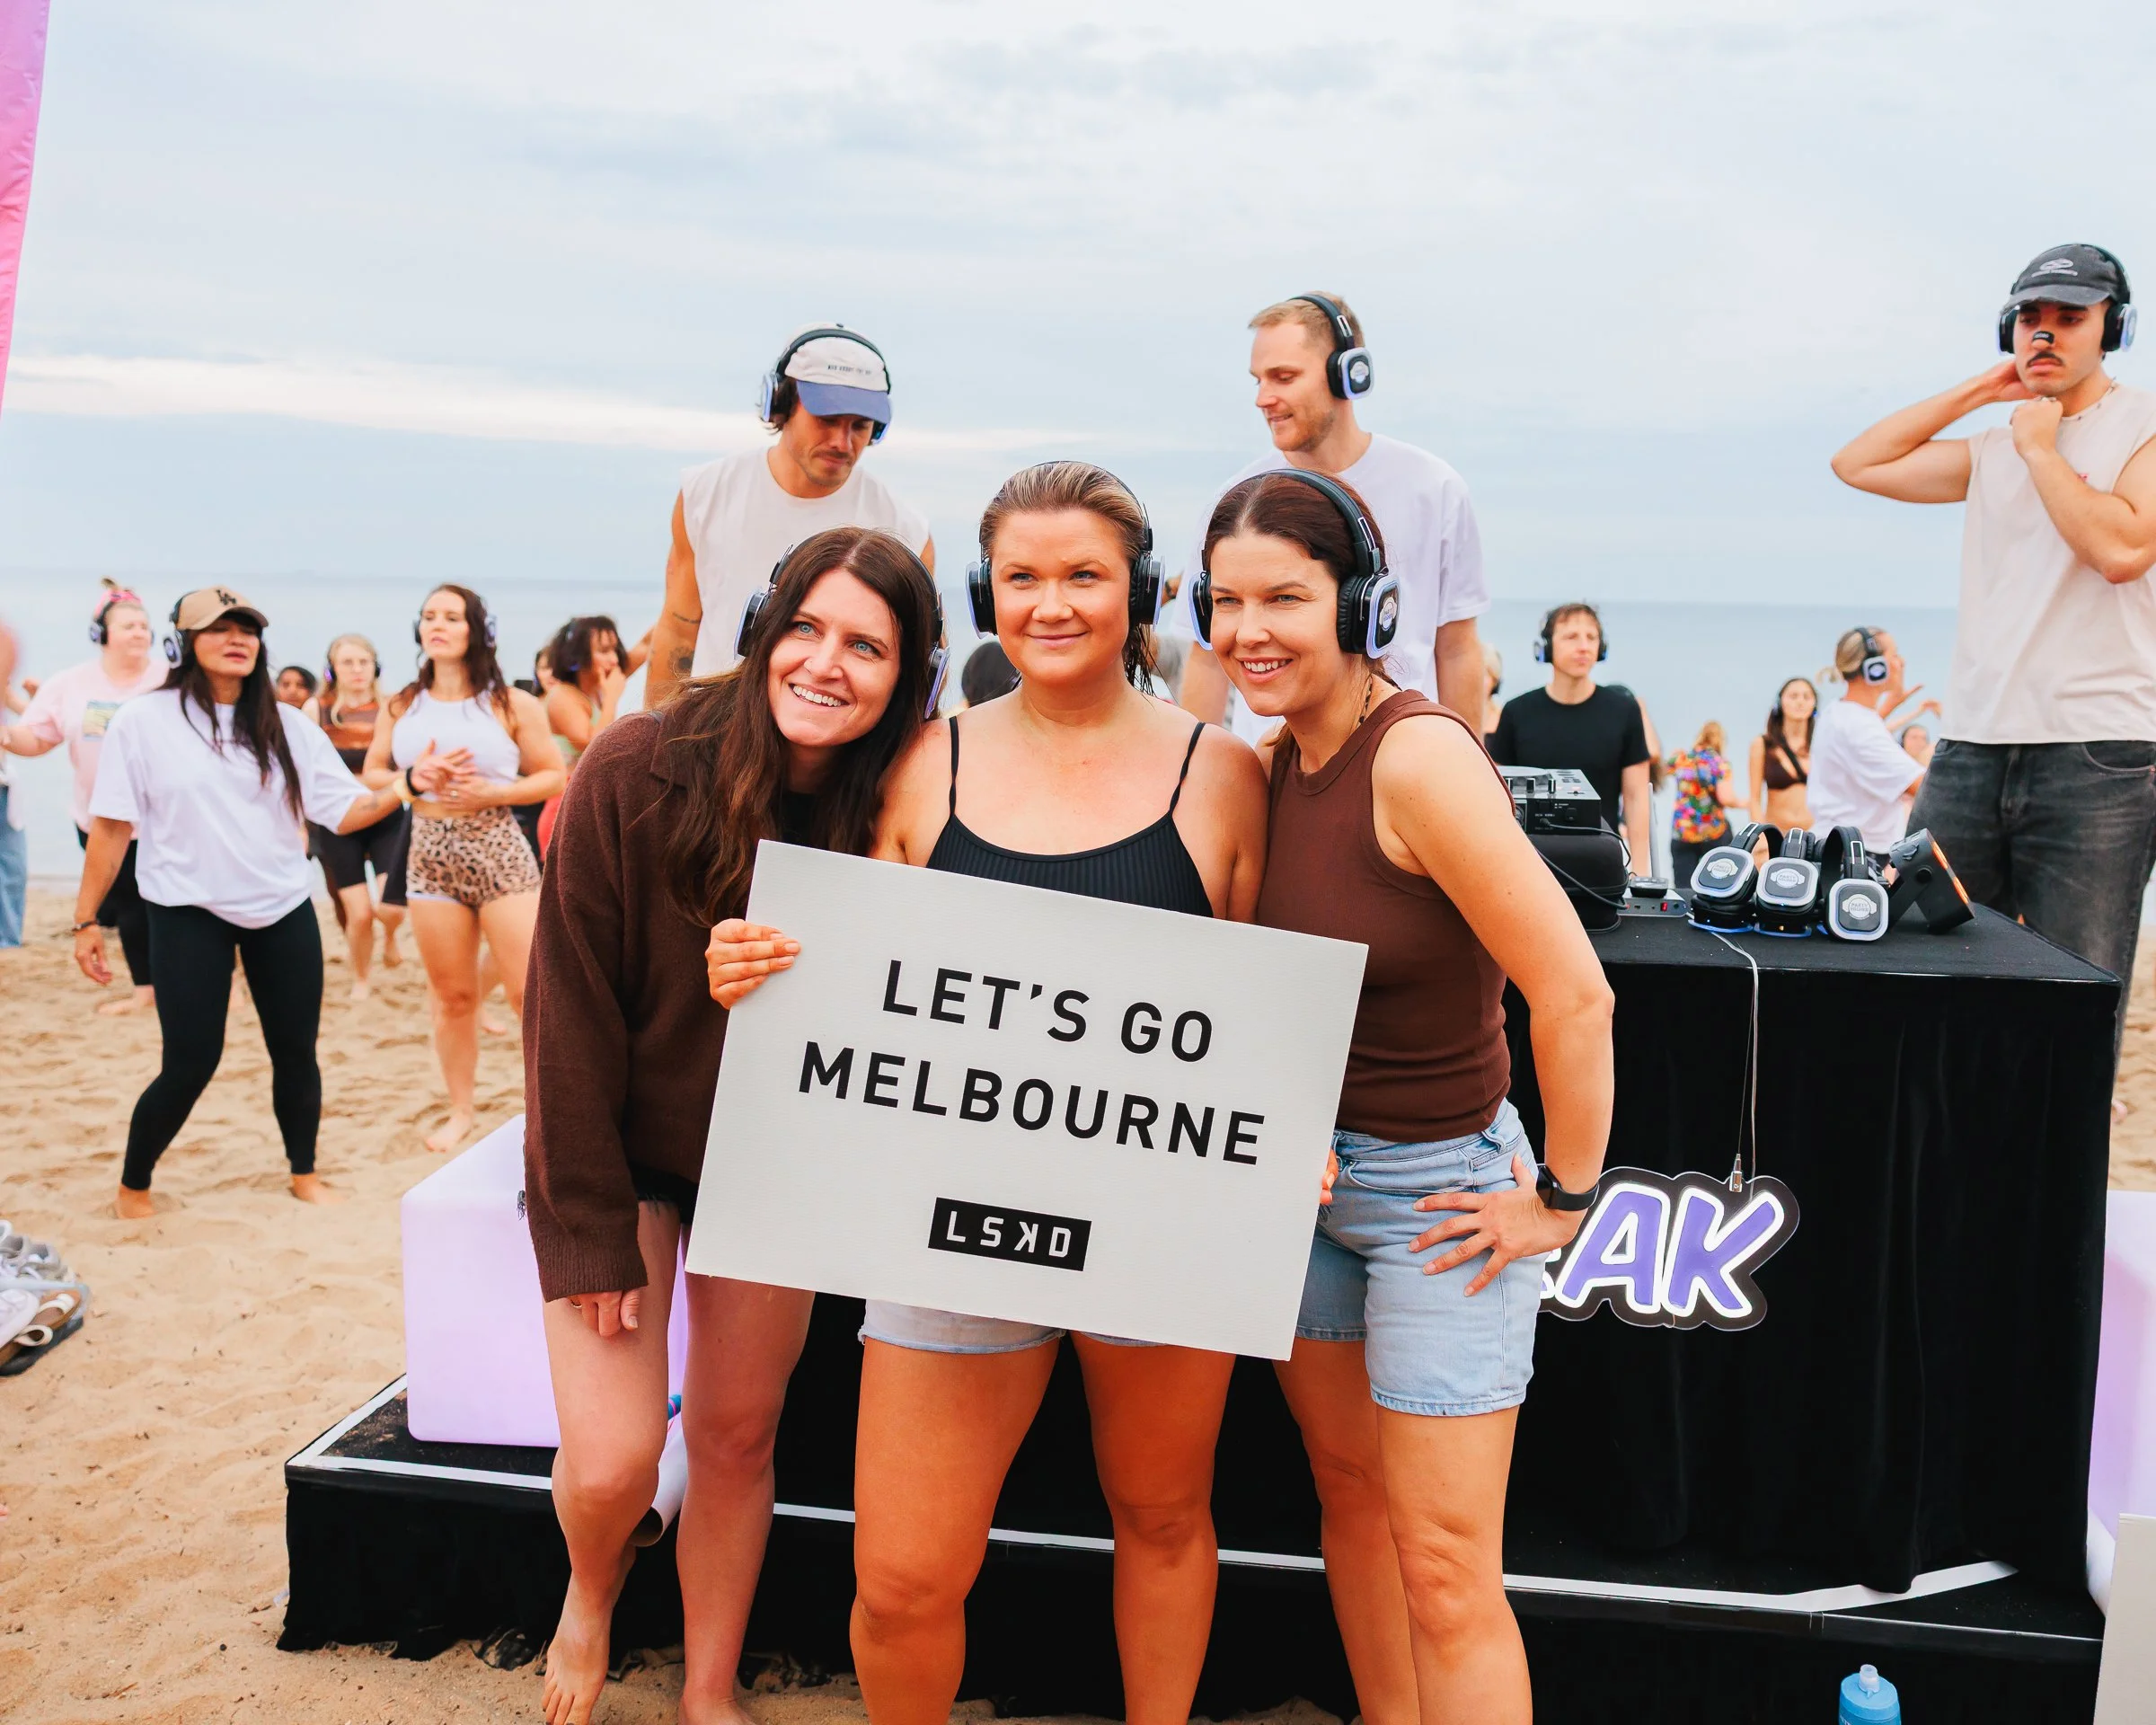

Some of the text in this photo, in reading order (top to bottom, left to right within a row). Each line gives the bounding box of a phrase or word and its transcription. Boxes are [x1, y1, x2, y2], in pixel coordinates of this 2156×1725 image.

[883, 960, 1212, 1062] LET'S GO
[800, 1041, 1264, 1164] MELBOURNE
